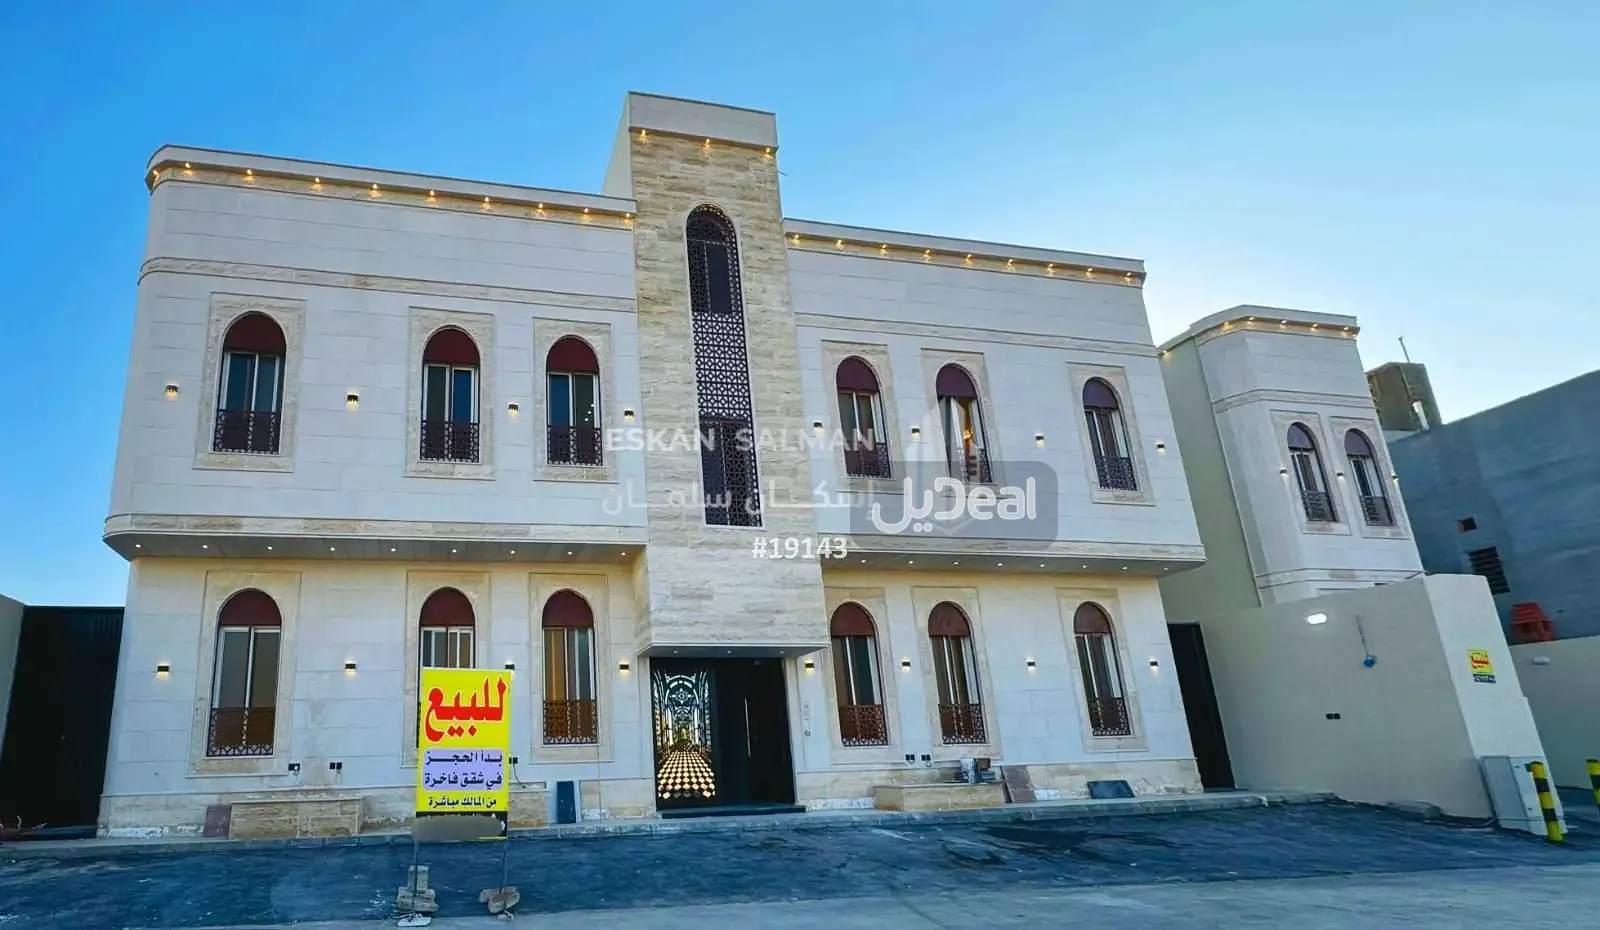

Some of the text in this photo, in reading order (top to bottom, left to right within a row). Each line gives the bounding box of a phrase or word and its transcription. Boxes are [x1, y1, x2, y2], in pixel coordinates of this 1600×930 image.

[424, 675, 508, 744] للبيع
[424, 771, 503, 790] في شقق فاخرة
[428, 795, 497, 809] من المالك مباشرة
